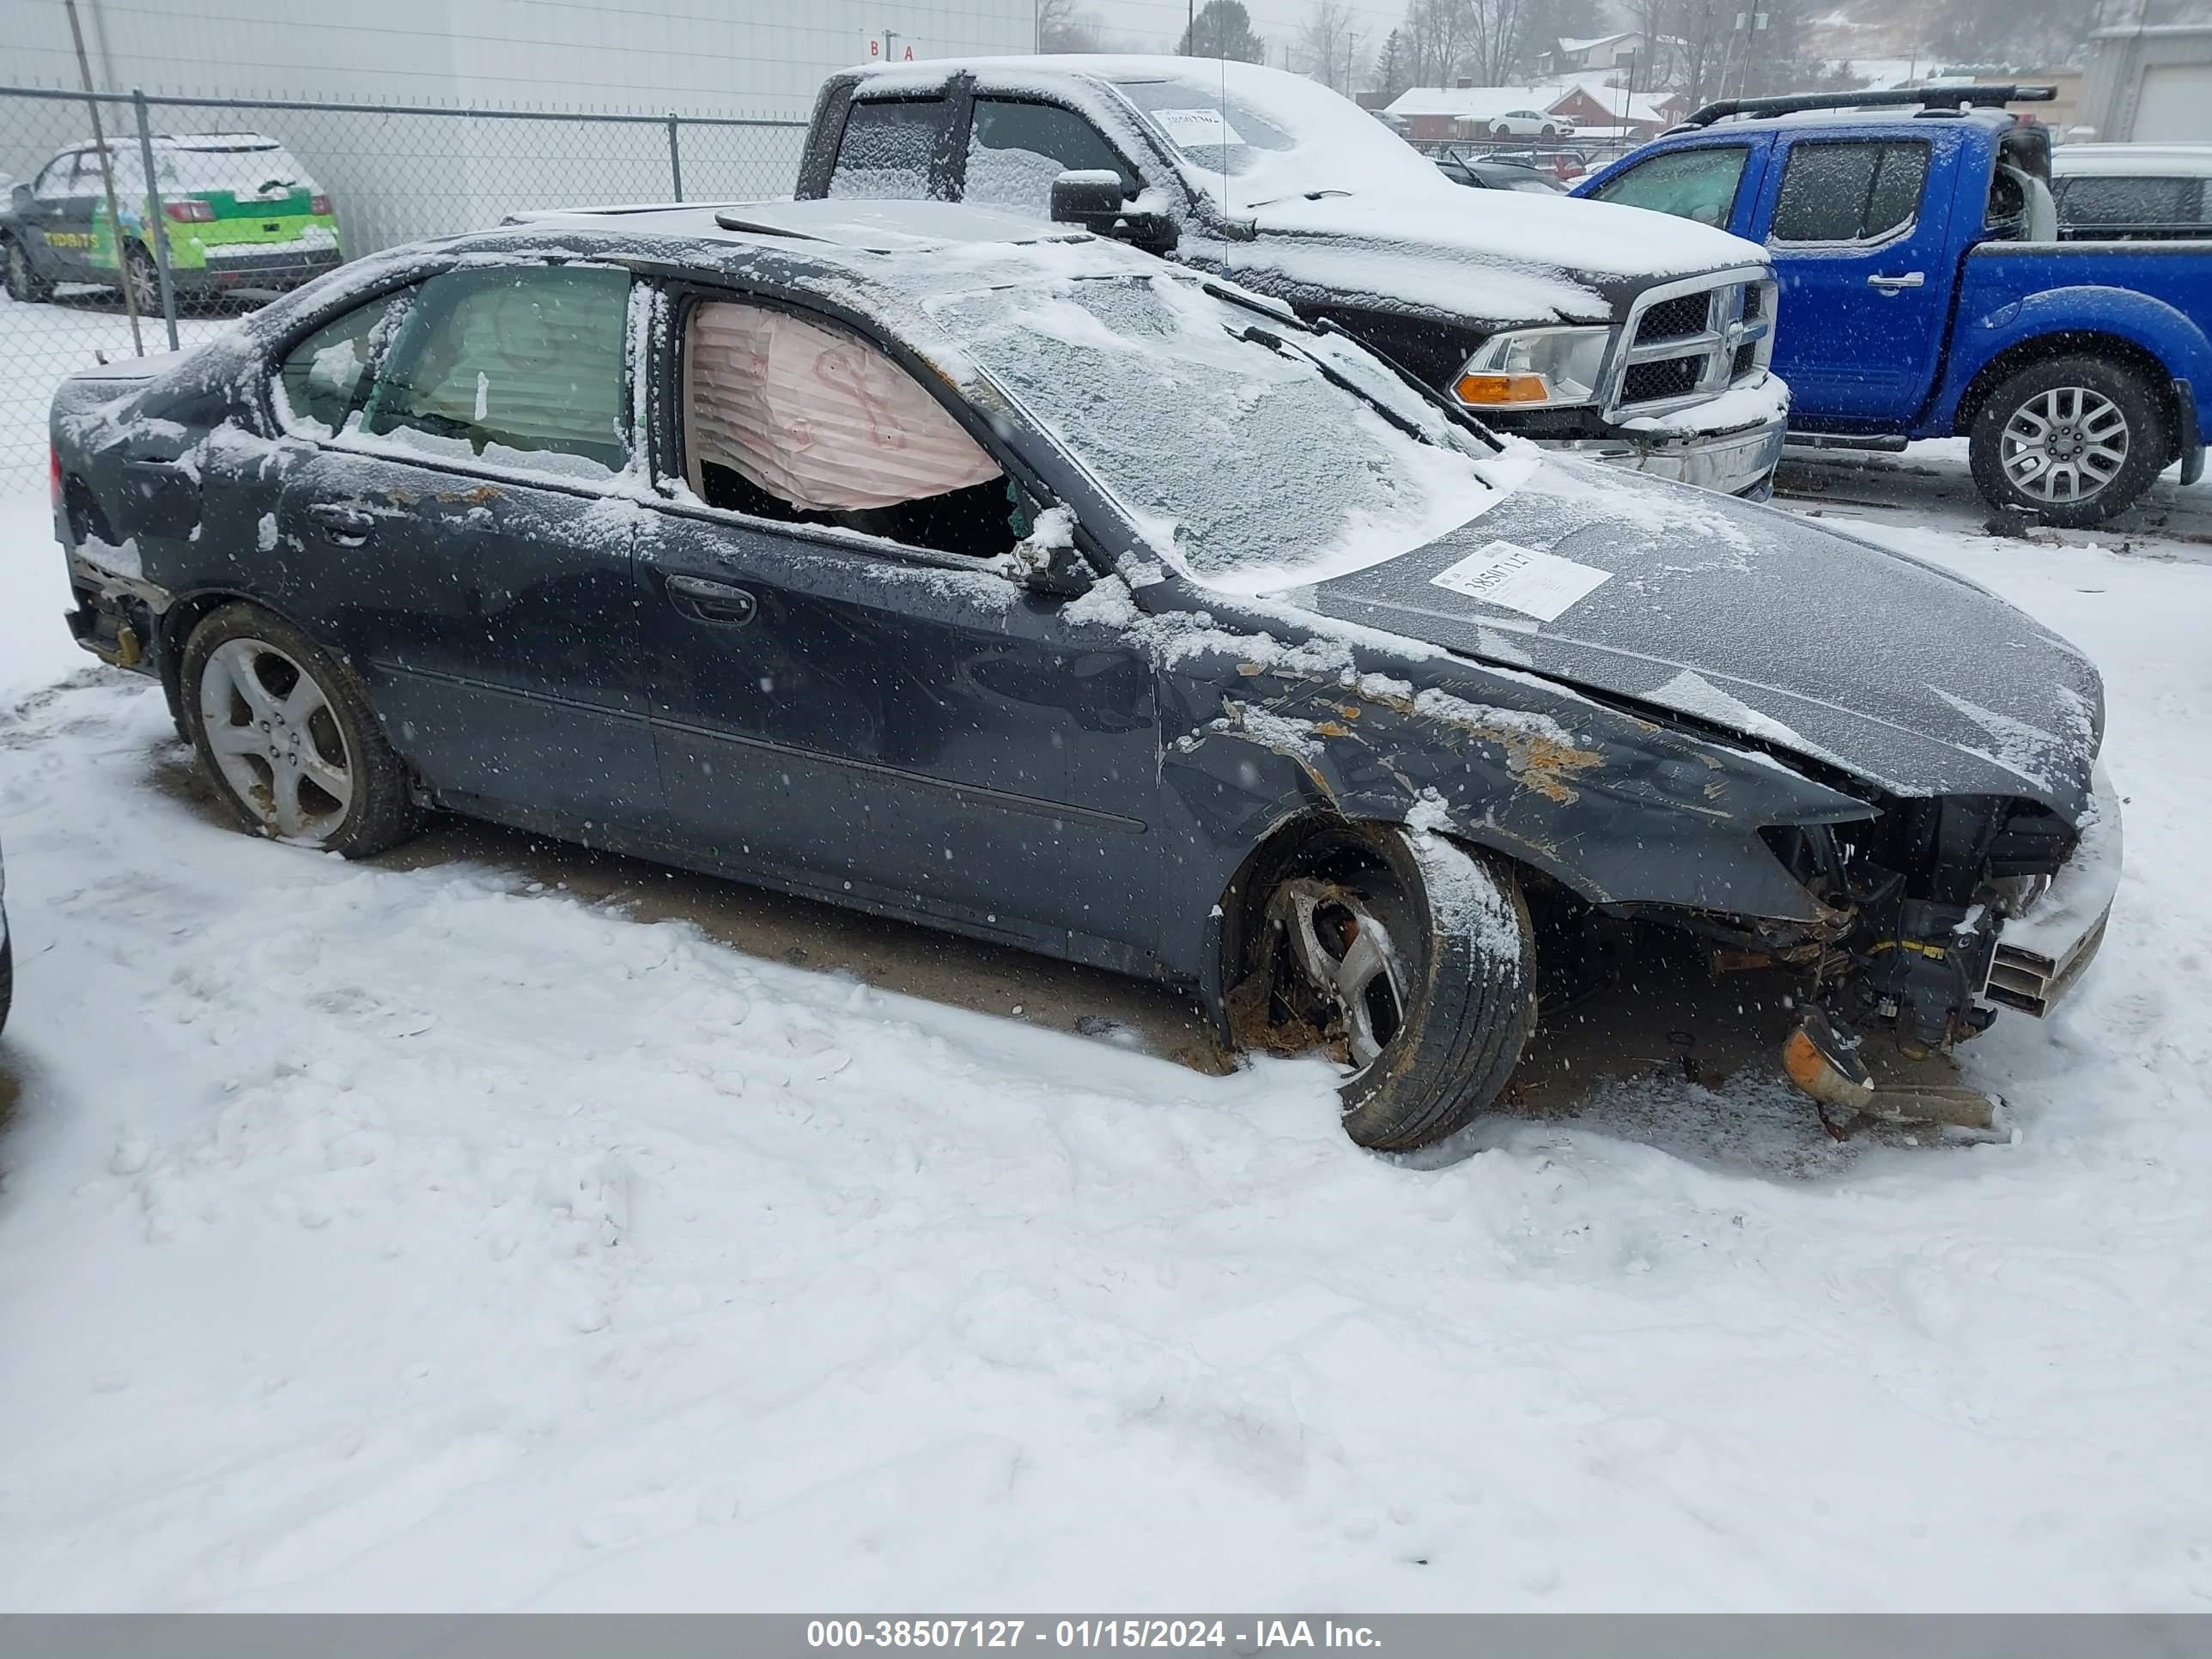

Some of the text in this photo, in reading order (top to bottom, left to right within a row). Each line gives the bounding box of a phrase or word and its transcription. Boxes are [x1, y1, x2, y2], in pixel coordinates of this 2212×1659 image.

[870, 40, 879, 56] B
[904, 46, 914, 61] A
[1464, 552, 1534, 592] 38507127
